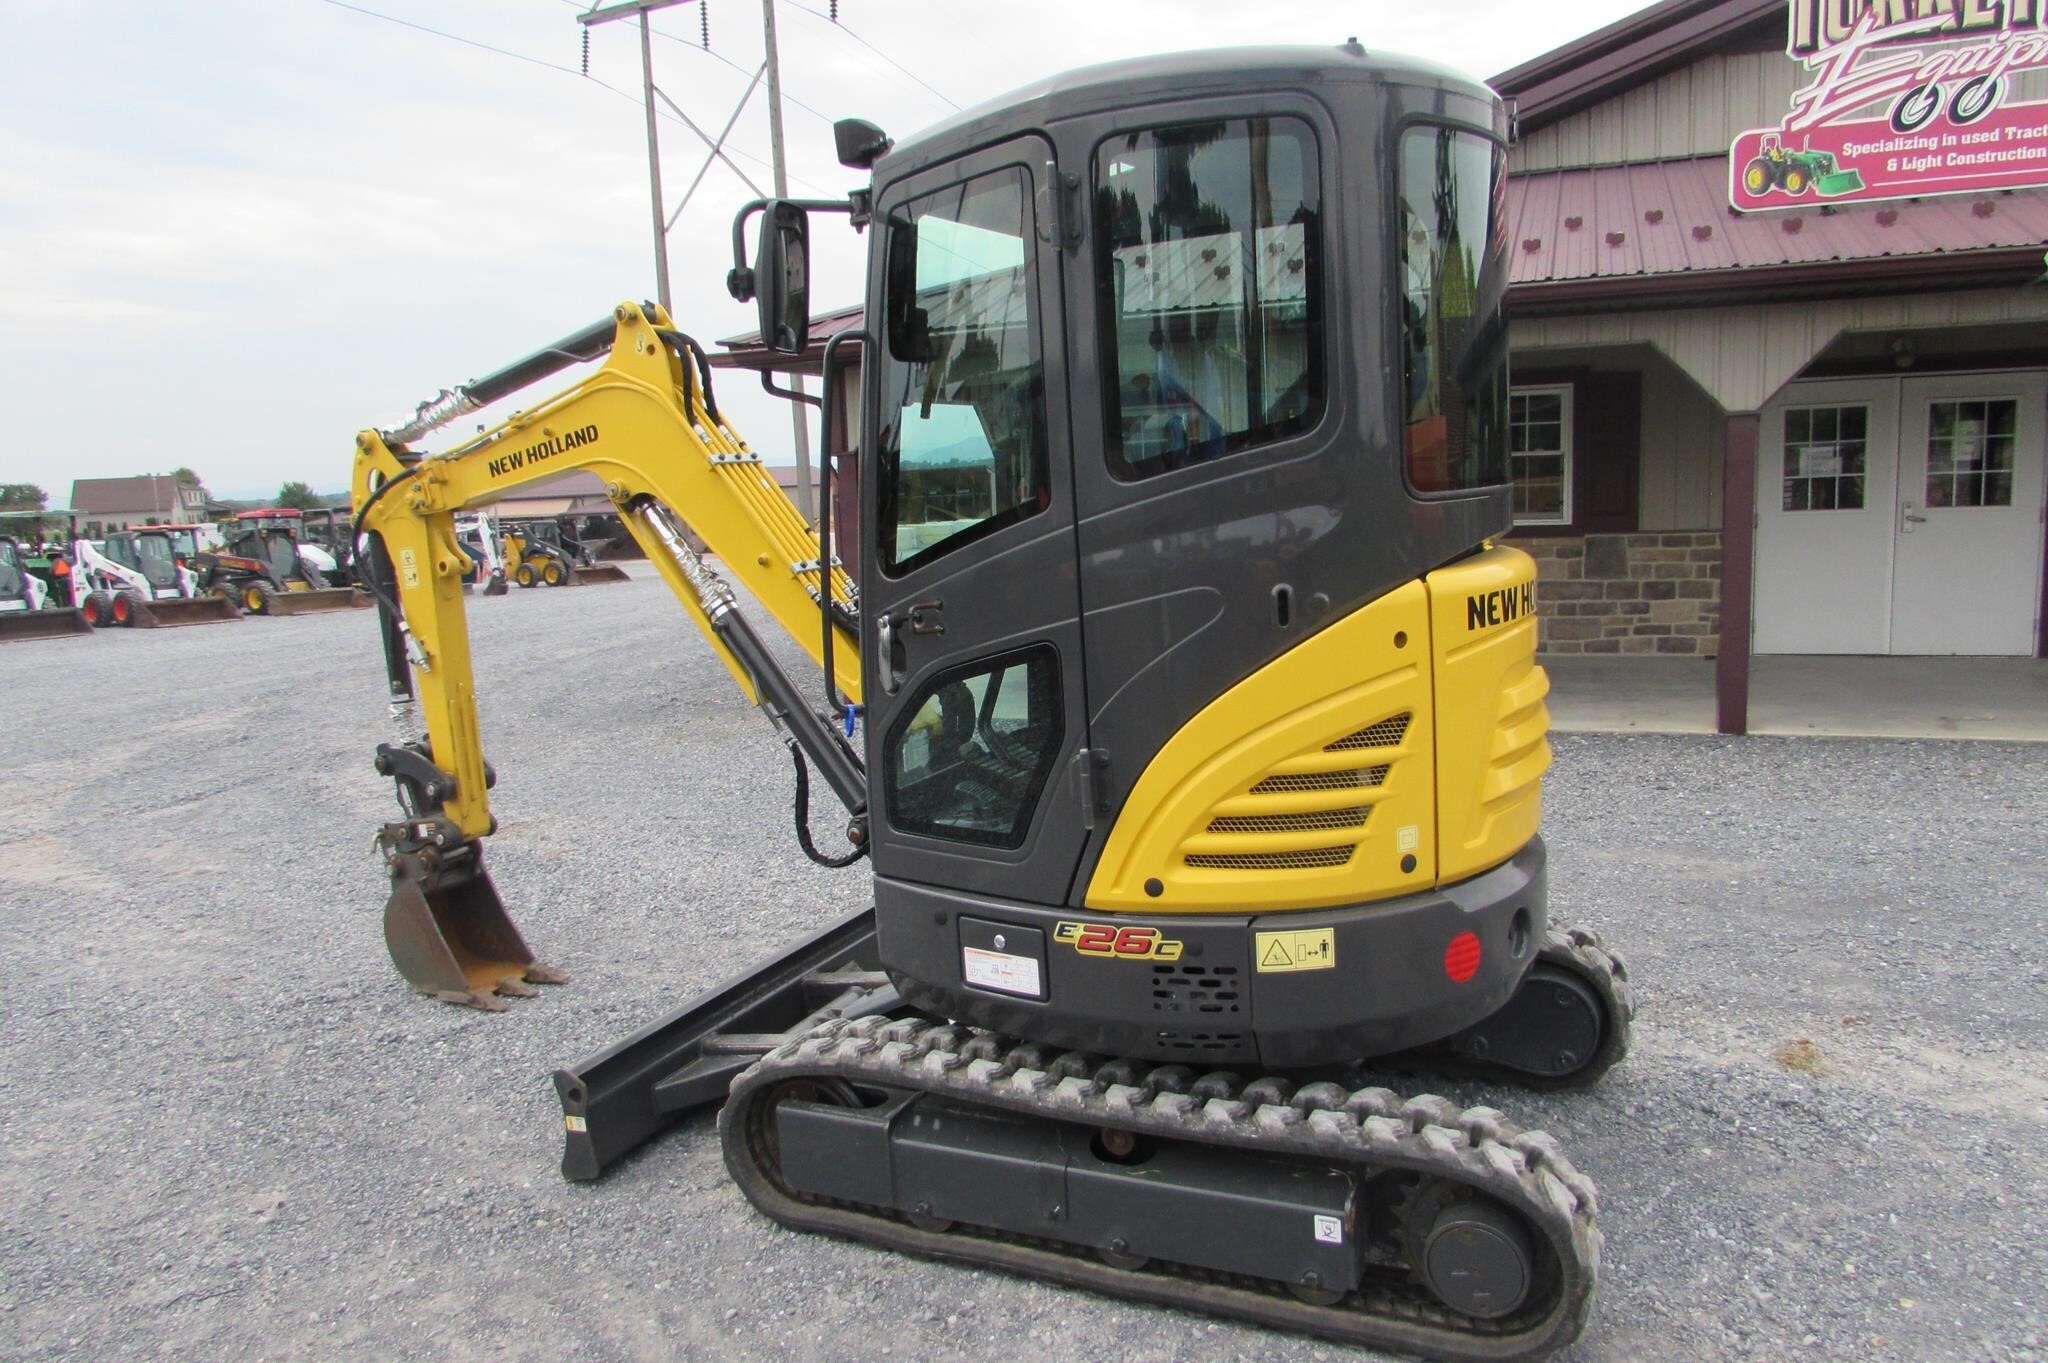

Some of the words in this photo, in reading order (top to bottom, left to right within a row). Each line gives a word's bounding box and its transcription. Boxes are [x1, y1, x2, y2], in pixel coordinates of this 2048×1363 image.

[1790, 11, 2048, 131] Equip
[1842, 135, 1939, 158] Specializing
[1942, 133, 1957, 147] in
[1961, 128, 1999, 144] used
[1886, 158, 1897, 172] &
[1902, 155, 1942, 172] Light
[1946, 146, 2047, 166] Construction
[488, 450, 524, 478] NEW
[526, 424, 599, 464] HOLLAND
[1467, 586, 1518, 631] NEW
[1055, 922, 1182, 958] E26C
